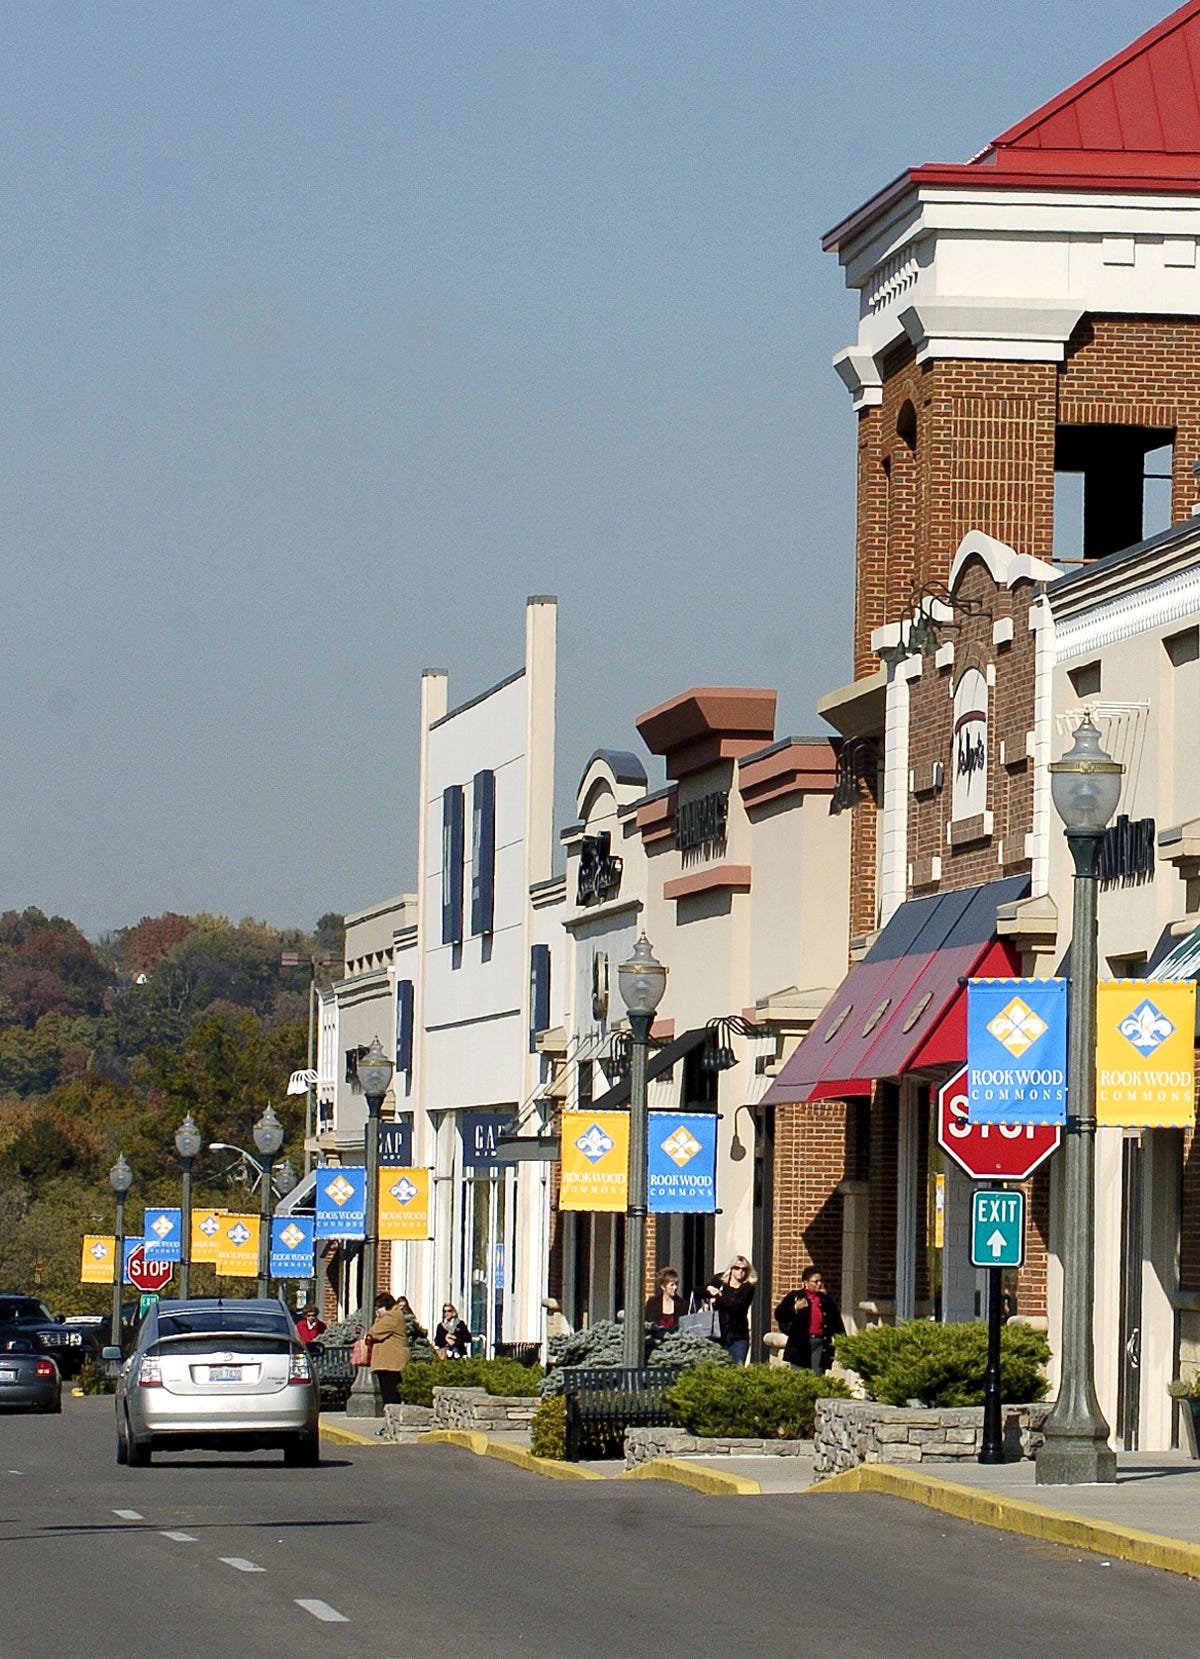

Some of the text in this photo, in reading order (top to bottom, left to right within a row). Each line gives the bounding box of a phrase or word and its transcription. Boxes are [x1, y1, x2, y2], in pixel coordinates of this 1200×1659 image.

[971, 1069, 1064, 1086] ROOKWOOD
[1100, 1071, 1192, 1088] ROOKWOOD
[971, 1088, 1064, 1101] COMMONS
[1100, 1089, 1192, 1102] COMMONS
[562, 1171, 627, 1185] ROOKWOOD
[650, 1173, 713, 1187] ROOKWOOD
[562, 1185, 627, 1195] COMMONS
[650, 1187, 713, 1197] COMMONS
[317, 1210, 364, 1220] ROOKWOOD
[978, 1199, 1017, 1223] EXIT
[131, 1260, 169, 1277] STOP
